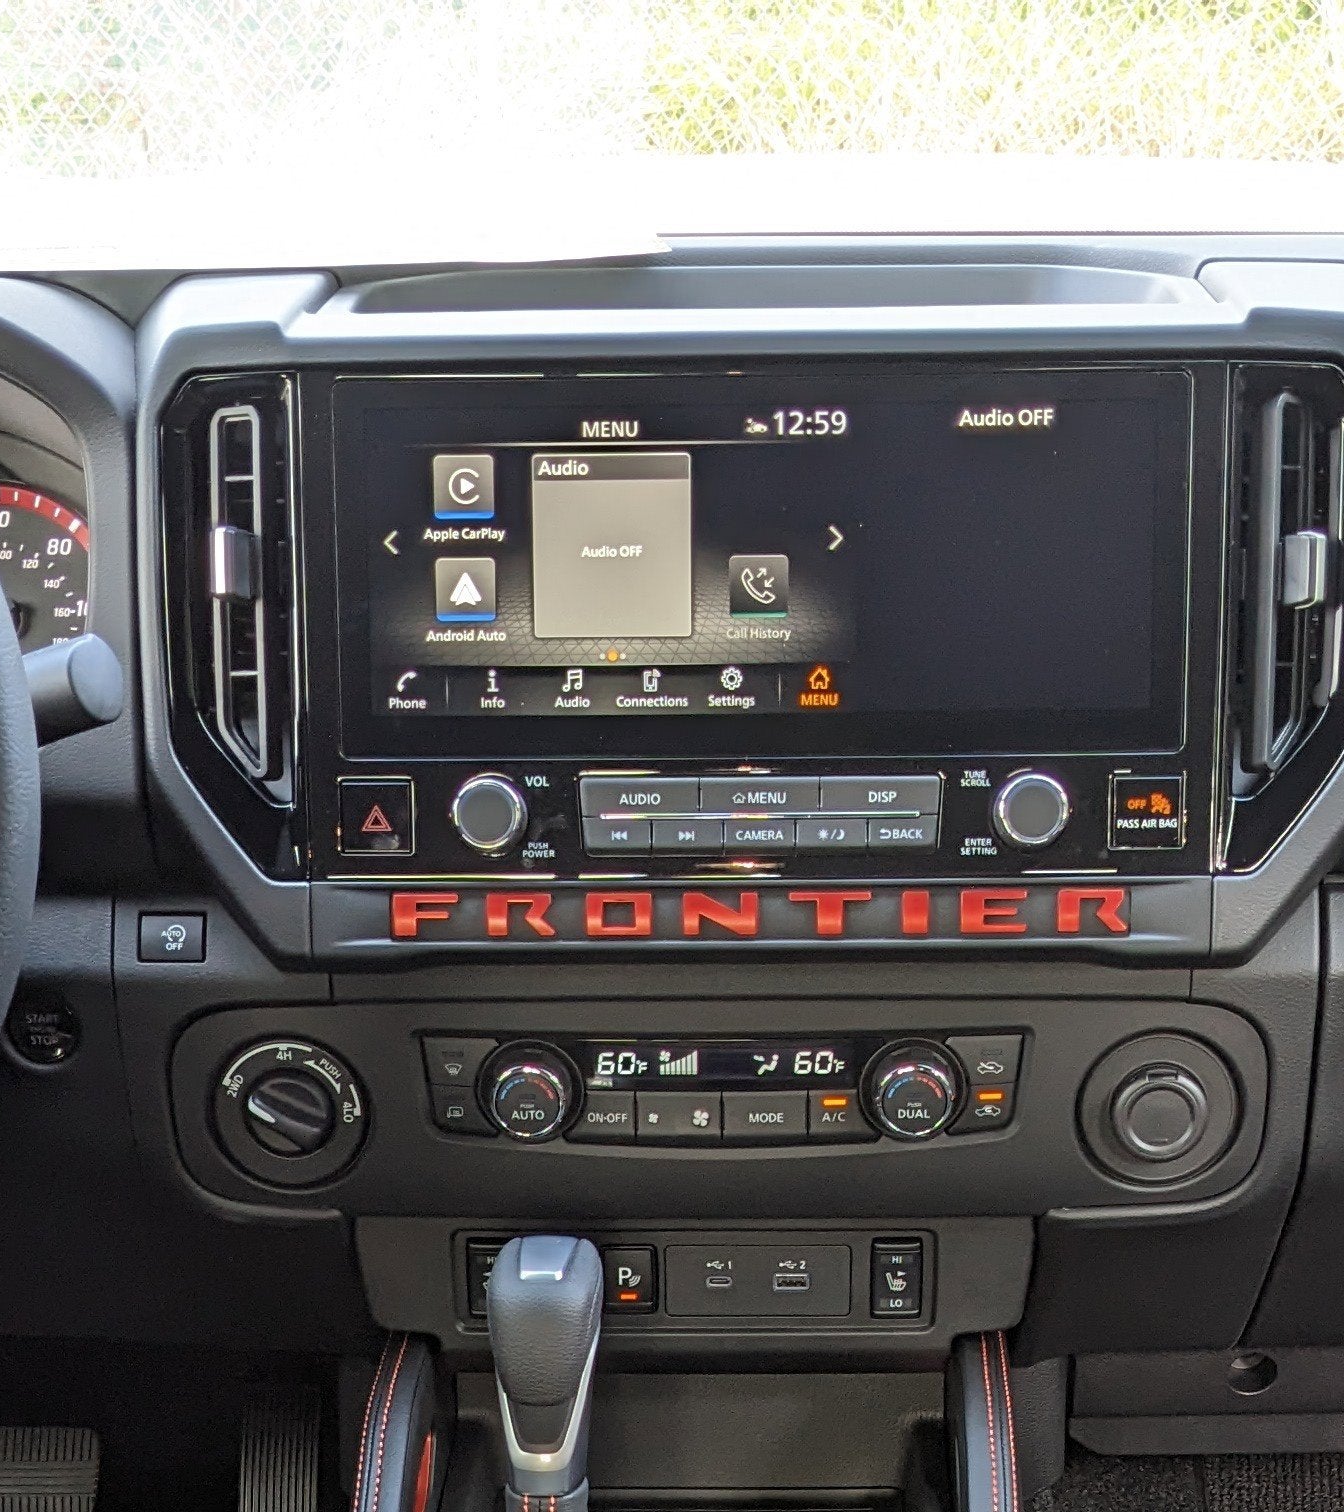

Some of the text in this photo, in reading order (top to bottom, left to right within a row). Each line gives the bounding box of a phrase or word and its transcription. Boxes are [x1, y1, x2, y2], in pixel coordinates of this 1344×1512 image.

[773, 410, 847, 436] 12:59
[959, 409, 1053, 427] Audio OFF
[582, 421, 639, 438] MENU
[537, 460, 589, 476] Audio
[423, 528, 506, 542] Apple CarPlay
[46, 538, 72, 555] 80
[581, 545, 643, 558] Audio OFF
[22, 559, 39, 569] 120
[43, 579, 60, 589] 140
[426, 630, 506, 642] Android Auto
[726, 628, 791, 641] Call History
[388, 697, 427, 709] Phone
[480, 696, 506, 709] Info
[555, 696, 591, 708] Audio
[616, 696, 688, 708] Connections
[708, 695, 755, 709] Settings
[801, 694, 839, 706] MENU
[963, 770, 986, 779] TUNE
[525, 776, 550, 787] VOL
[960, 778, 991, 787] SCROLL
[619, 793, 661, 805] AUDIO
[747, 792, 787, 804] MENU
[868, 791, 897, 803] DISP
[1127, 798, 1147, 810] OFF
[1117, 818, 1178, 829] PASS AIR BAG
[735, 830, 784, 841] CAMERA
[892, 828, 923, 840] BACK
[528, 842, 549, 850] PUSH
[964, 838, 992, 847] ENTER
[522, 850, 555, 858] POWER
[960, 846, 997, 856] SETTING
[390, 888, 1130, 939] FRONTIER
[165, 941, 183, 951] OFF
[275, 1050, 292, 1061] 4H
[318, 1057, 342, 1080] PUSH
[226, 1073, 244, 1098] 2WD
[341, 1100, 355, 1124] 4LO
[511, 1109, 545, 1121] AUTO
[748, 1112, 784, 1123] MODE
[822, 1112, 846, 1123] A/C
[897, 1108, 931, 1119] DUAL
[799, 1260, 806, 1270] 2
[891, 1255, 903, 1264] HI
[618, 1267, 632, 1286] P
[889, 1298, 903, 1308] LO
